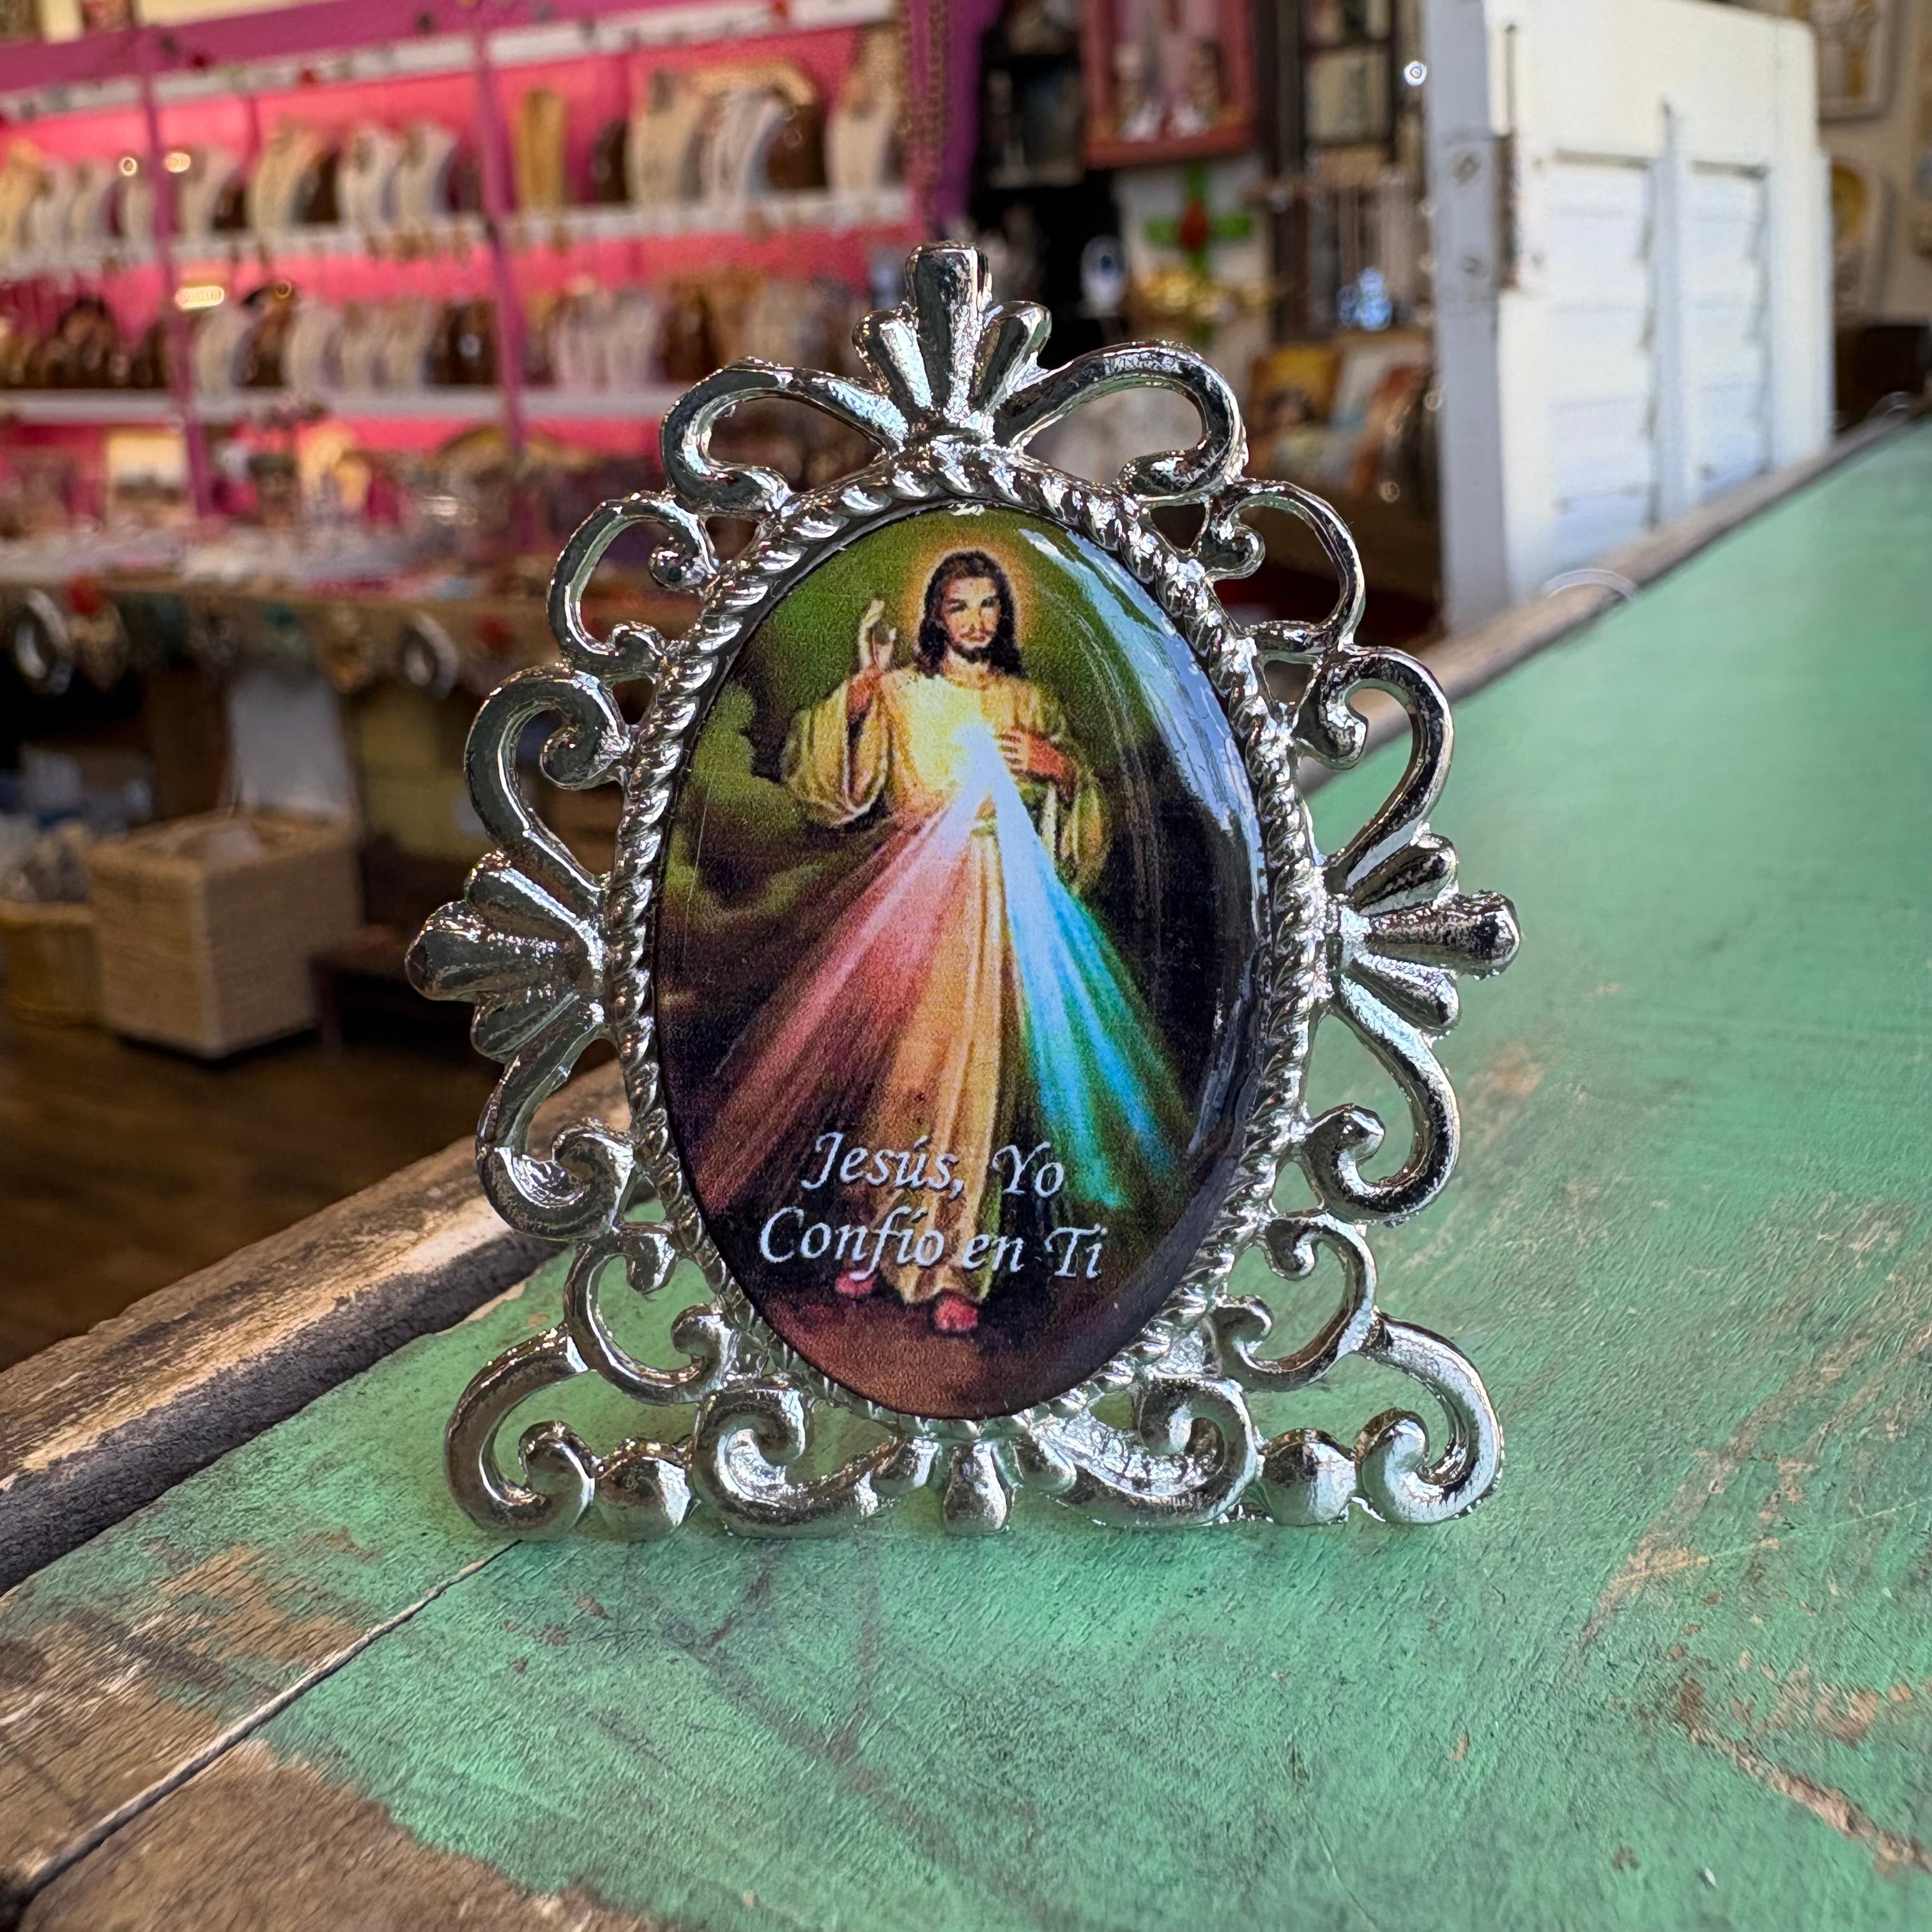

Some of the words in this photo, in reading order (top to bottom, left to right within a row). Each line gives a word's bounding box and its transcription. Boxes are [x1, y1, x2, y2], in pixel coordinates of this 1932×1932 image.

[801, 1131, 965, 1199] Jesús,
[992, 1141, 1064, 1197] Yo
[759, 1206, 945, 1280] Confío
[962, 1232, 1025, 1273] en
[1044, 1222, 1108, 1278] Ti
